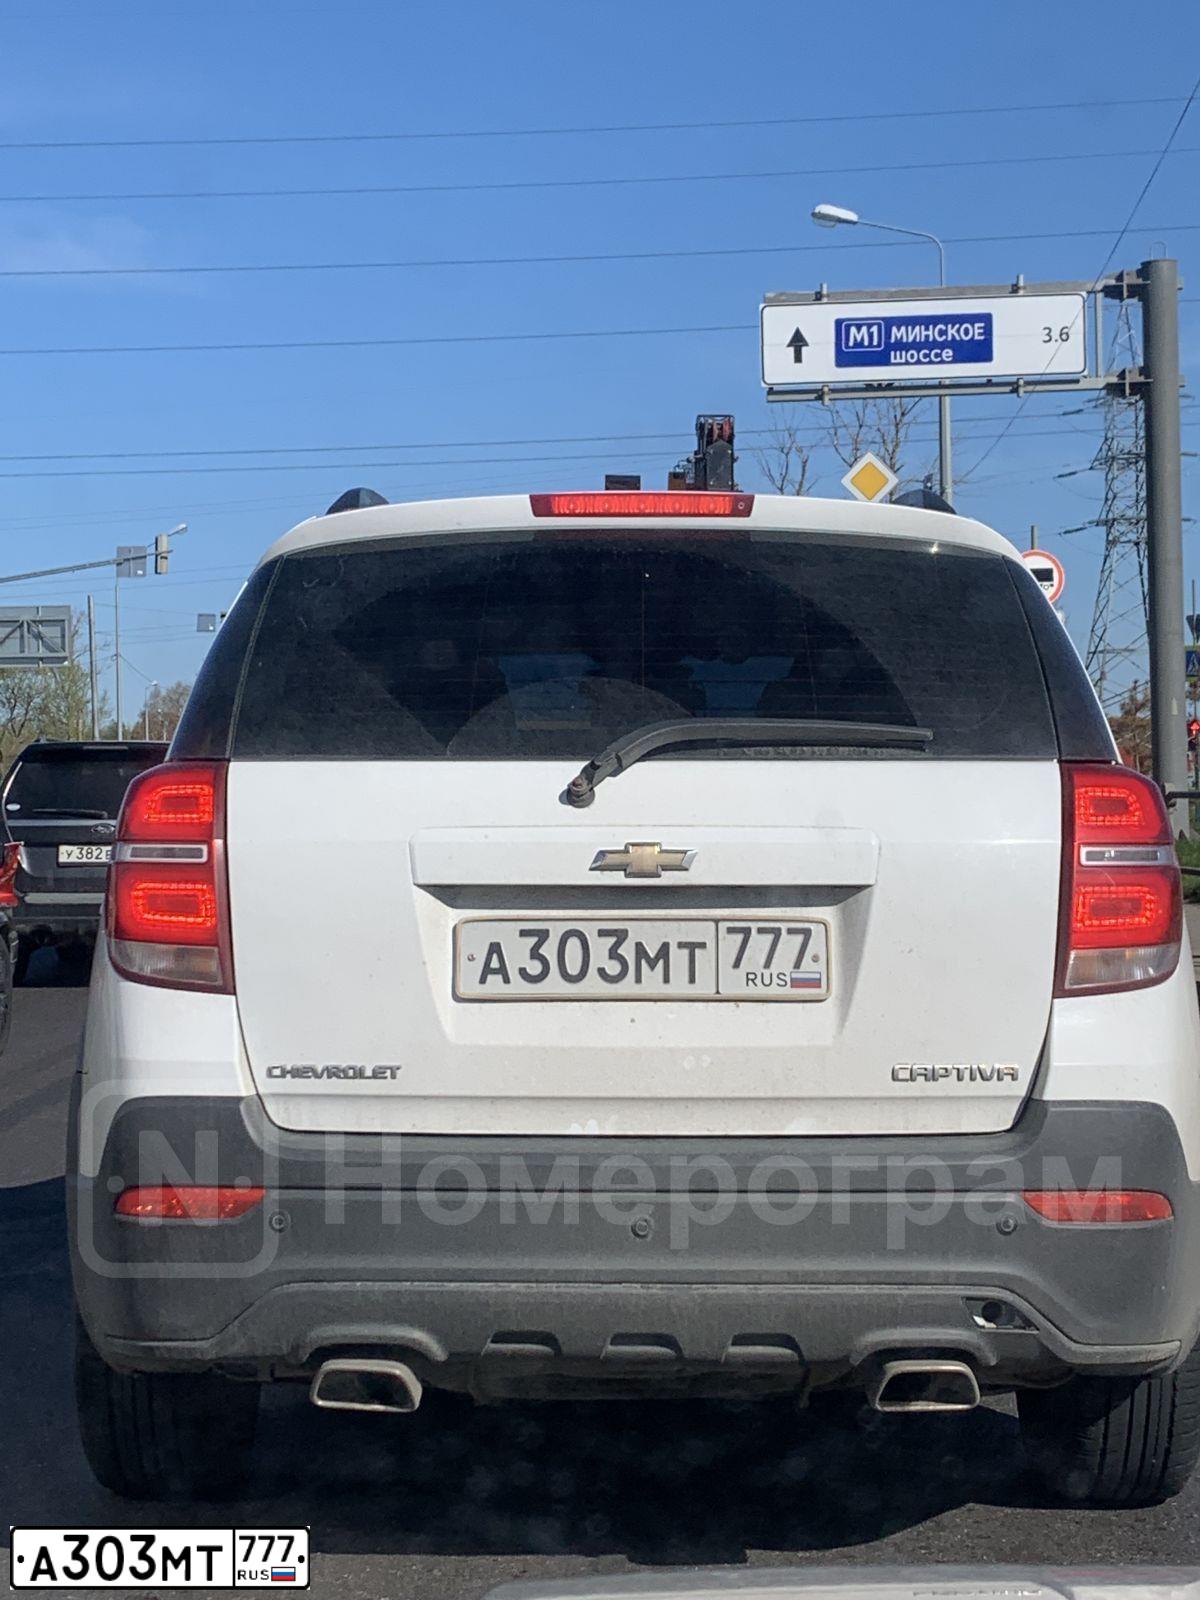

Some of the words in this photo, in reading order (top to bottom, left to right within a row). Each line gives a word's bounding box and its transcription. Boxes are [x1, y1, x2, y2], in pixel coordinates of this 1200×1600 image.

[848, 324, 879, 347] М1
[890, 322, 985, 344] МИНСКОЕ
[1042, 326, 1071, 344] 3.6
[890, 348, 954, 364] шоссе
[478, 928, 707, 985] А303МТ
[726, 926, 813, 970] 777
[745, 972, 788, 988] RUS
[266, 1064, 402, 1080] CHEVROLET
[892, 1063, 1020, 1082] CAPTIVA
